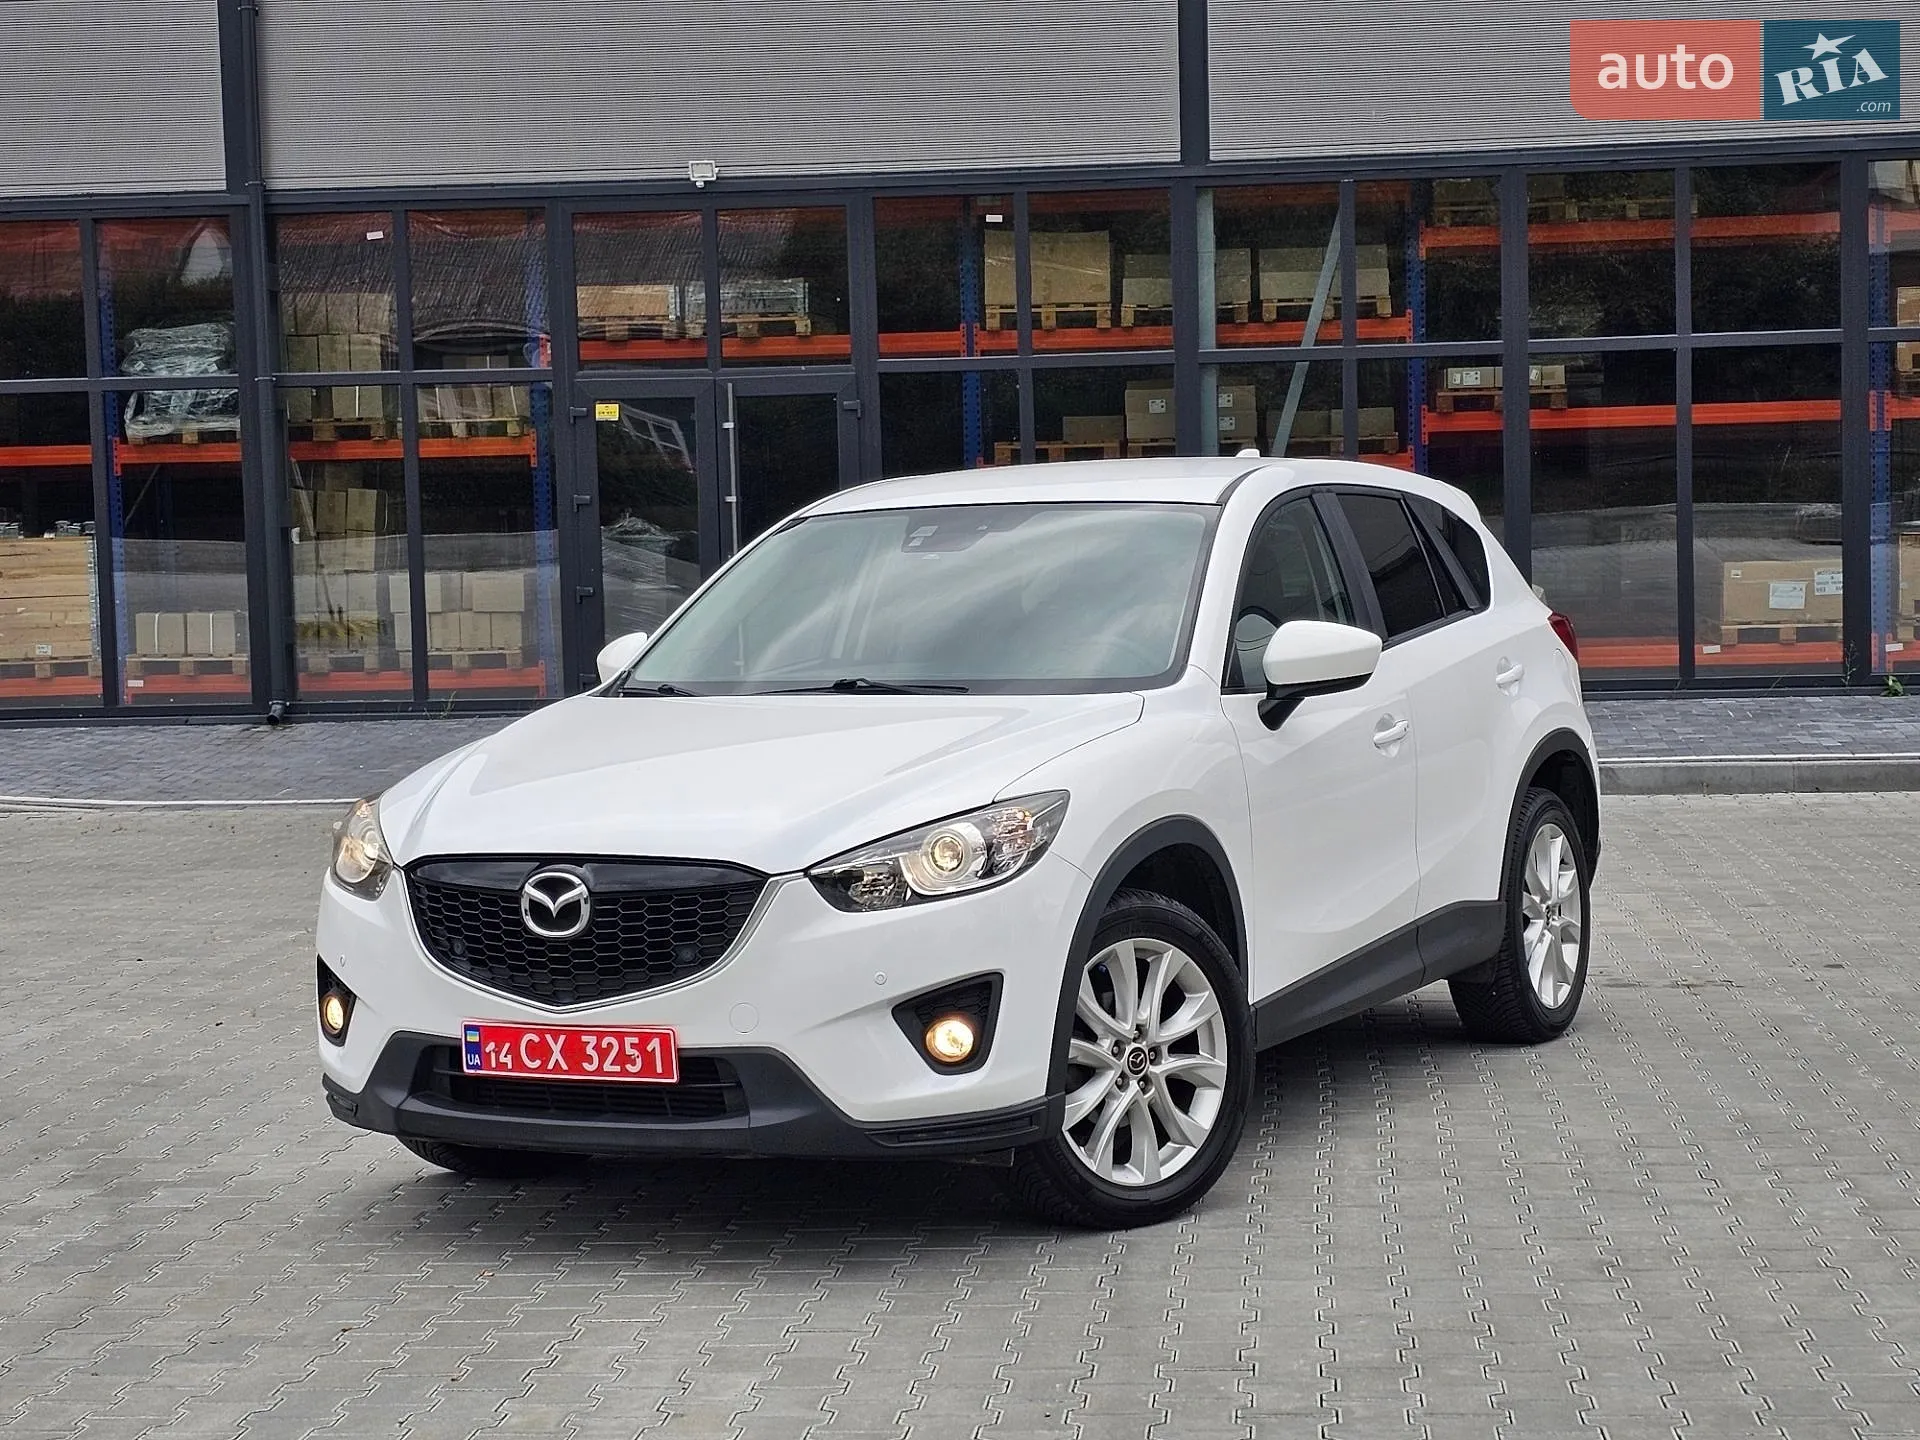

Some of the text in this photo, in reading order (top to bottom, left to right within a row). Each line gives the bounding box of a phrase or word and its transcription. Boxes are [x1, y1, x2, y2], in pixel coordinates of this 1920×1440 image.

[467, 1054, 481, 1067] UA
[484, 1033, 664, 1074] 14 CX 3251
